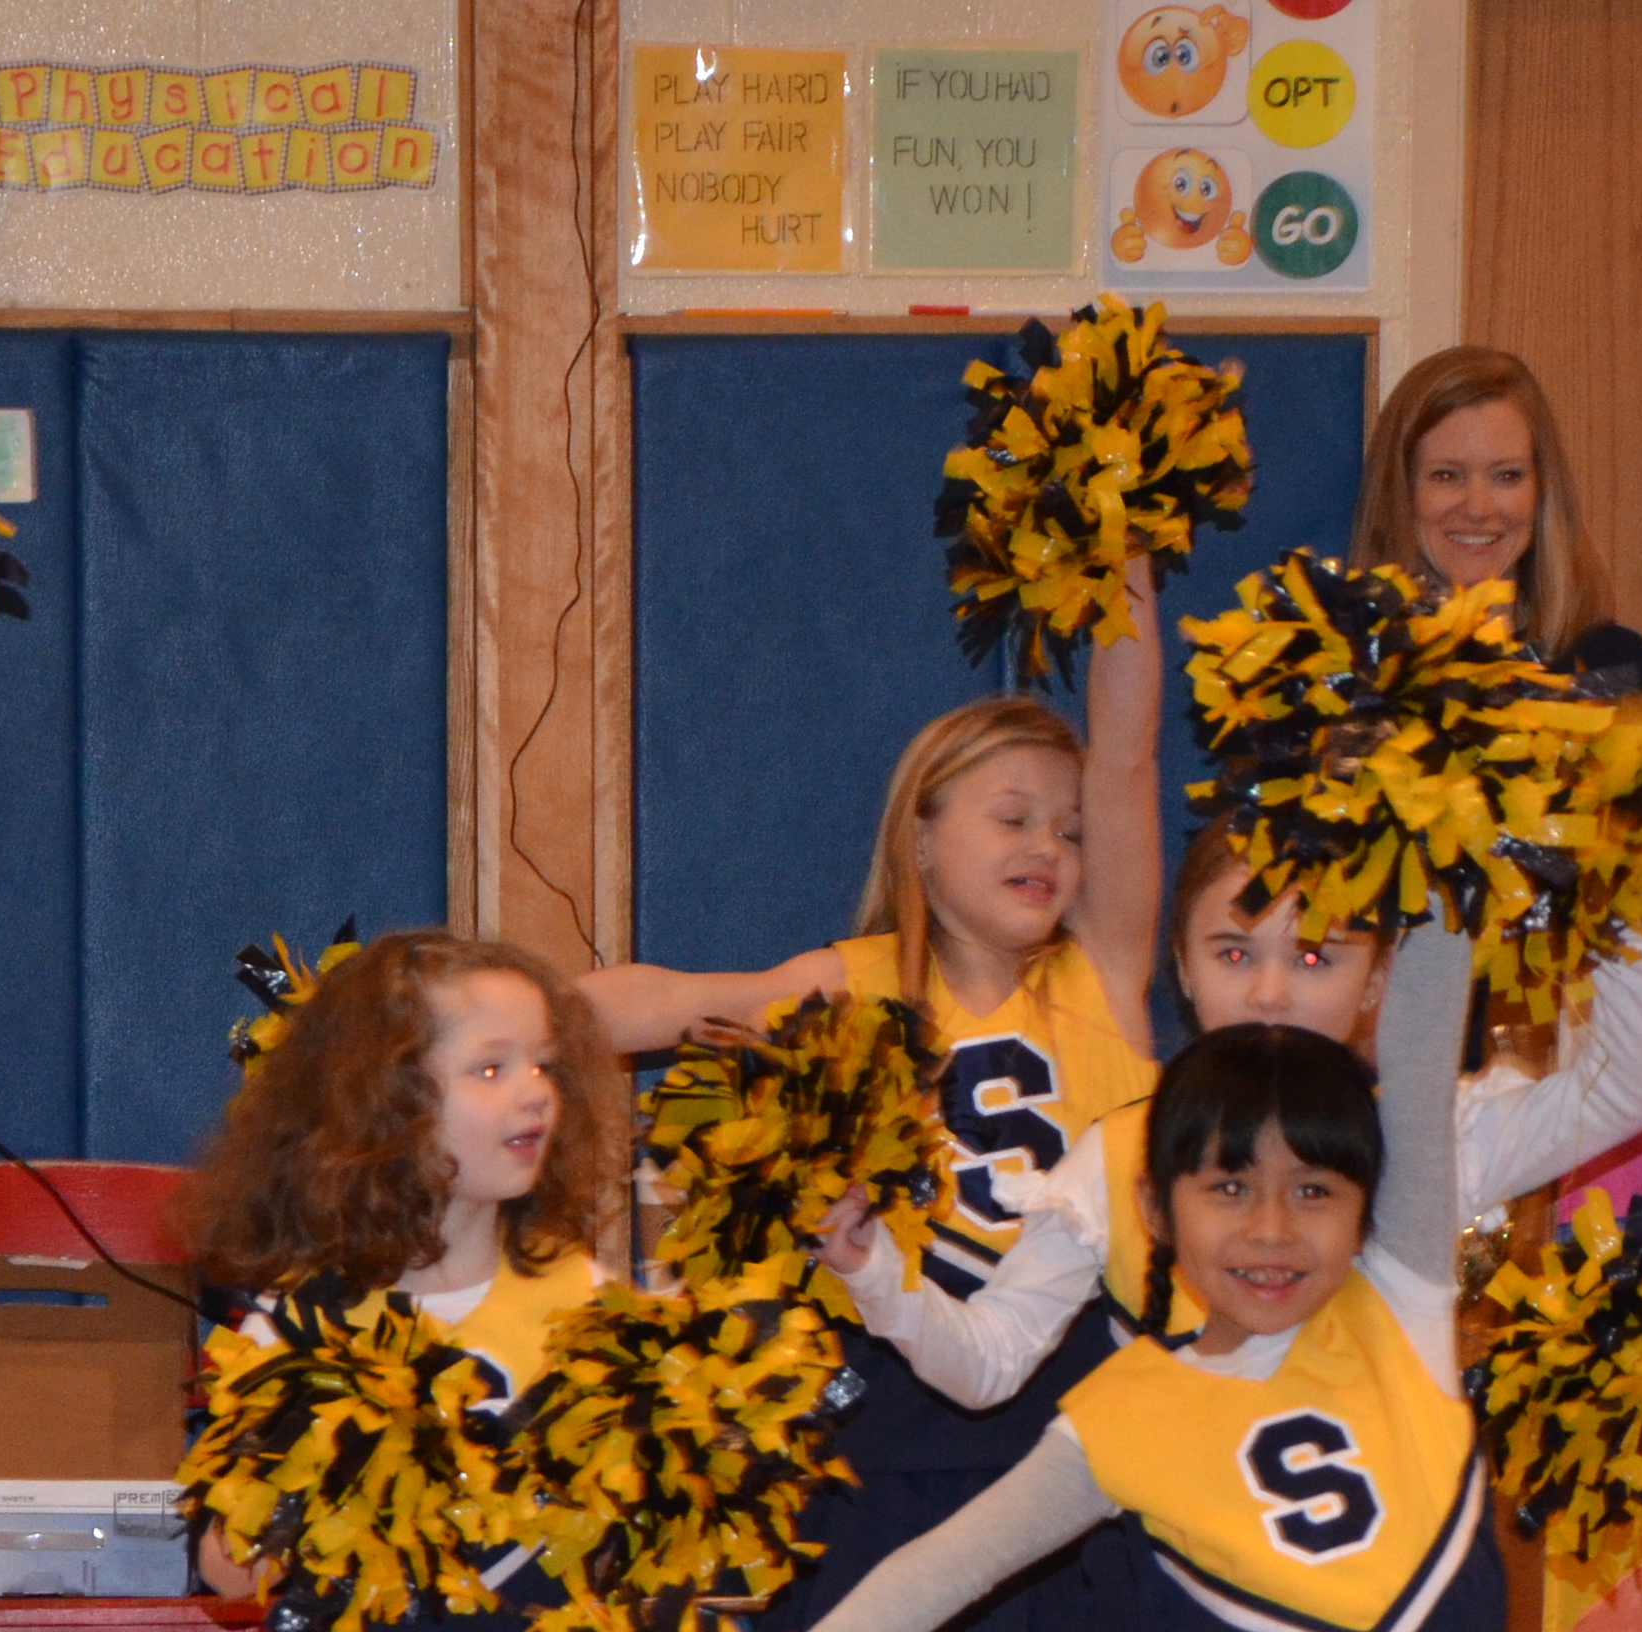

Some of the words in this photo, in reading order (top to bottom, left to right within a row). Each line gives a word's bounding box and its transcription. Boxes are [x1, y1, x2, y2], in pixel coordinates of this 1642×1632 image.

[10, 71, 385, 121] Physical
[655, 74, 728, 105] PLAY
[743, 73, 828, 105] HARD
[929, 70, 989, 100] YOU
[995, 71, 1051, 101] HAD
[1263, 76, 1340, 108] OPT
[655, 122, 727, 153] PLAY
[743, 116, 807, 153] FAIR
[893, 136, 962, 171] FUN,
[976, 137, 1037, 168] YOU
[656, 173, 782, 204] NOBODY
[742, 214, 822, 245] HURT
[1271, 205, 1339, 245] GO
[941, 1032, 1070, 1232] S
[1236, 1405, 1386, 1566] S
